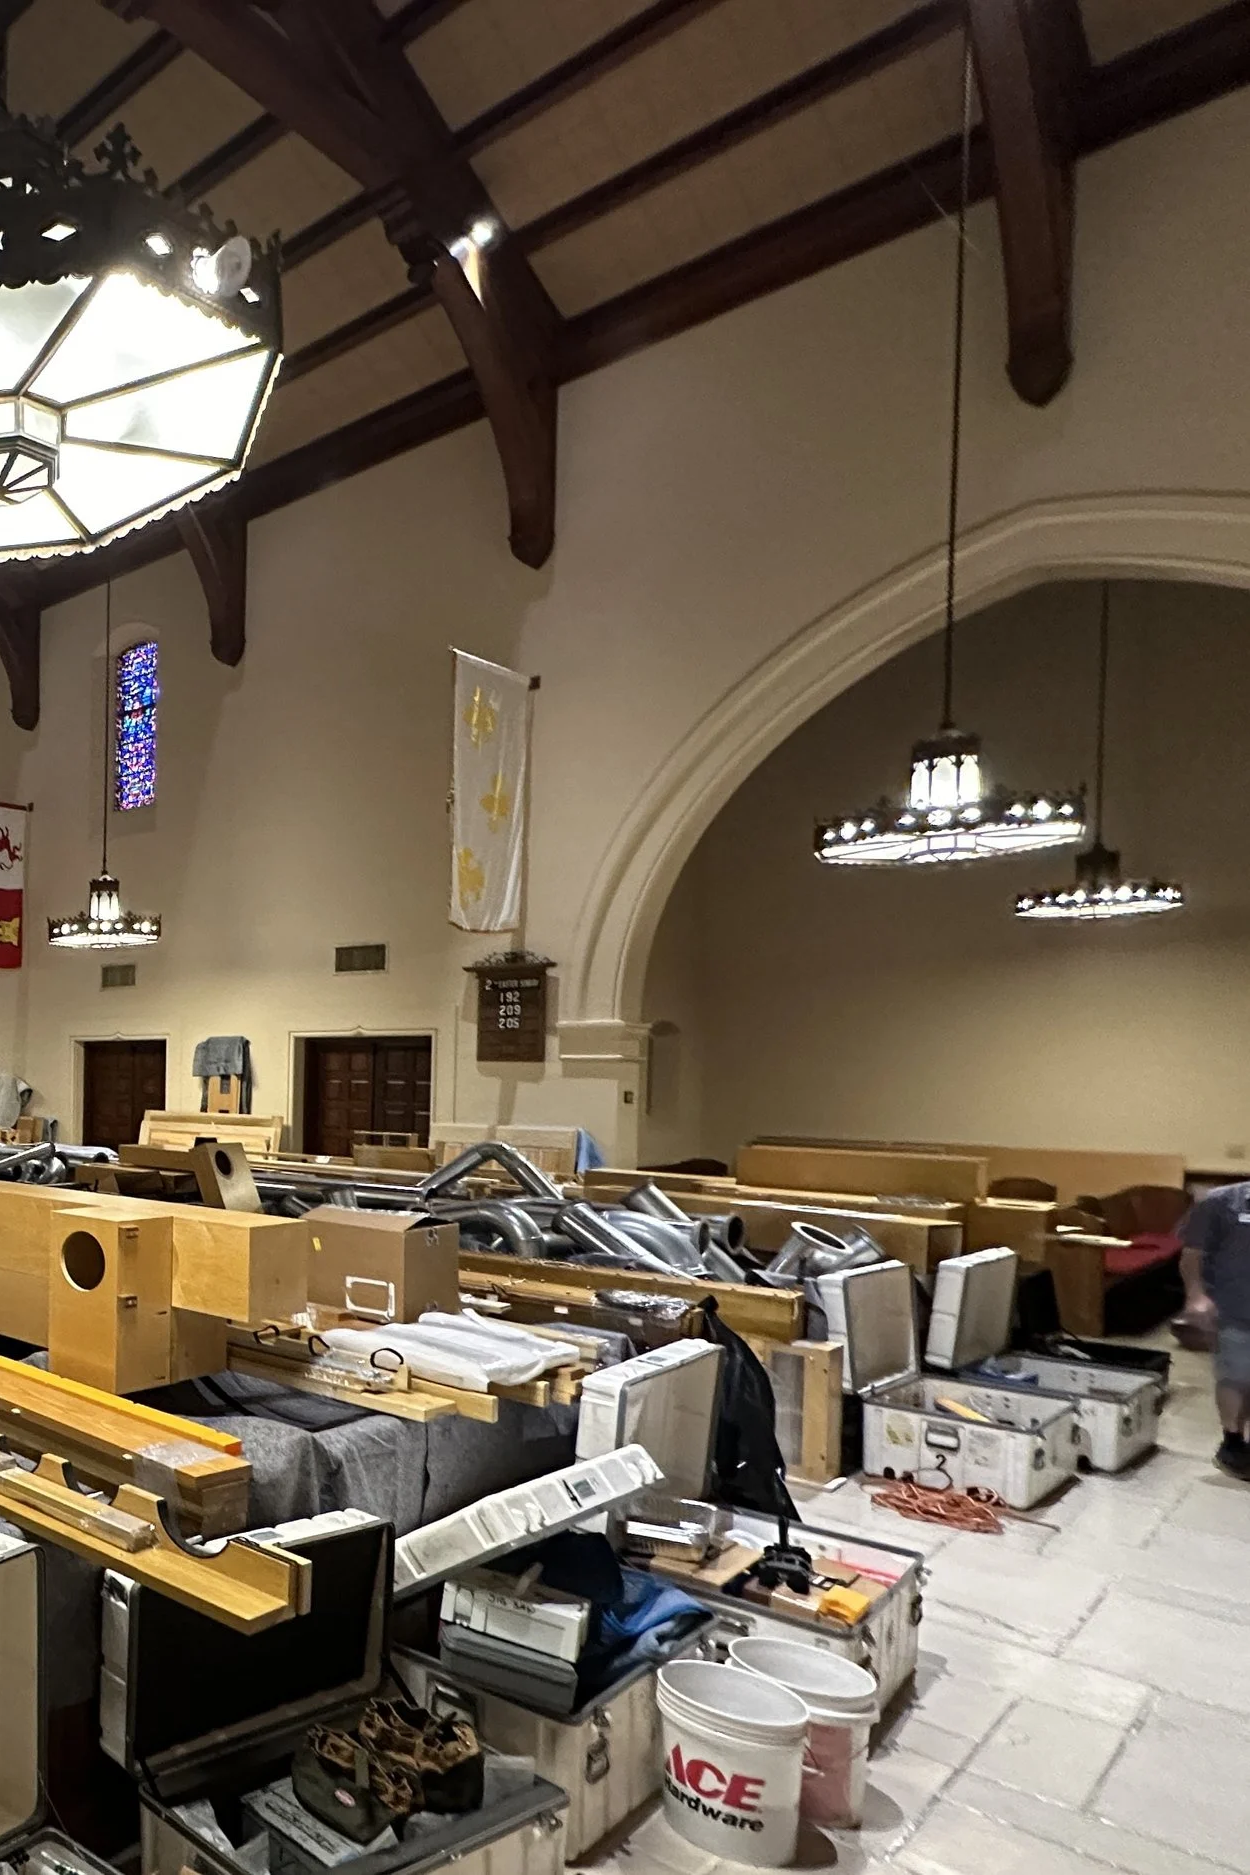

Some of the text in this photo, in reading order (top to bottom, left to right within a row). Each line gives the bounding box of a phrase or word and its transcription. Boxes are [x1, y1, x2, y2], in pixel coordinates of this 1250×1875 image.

[500, 991, 520, 1002] 192
[499, 1005, 521, 1015] 209
[499, 1017, 519, 1028] 205
[936, 1454, 947, 1470] 2
[665, 1743, 766, 1813] ACE
